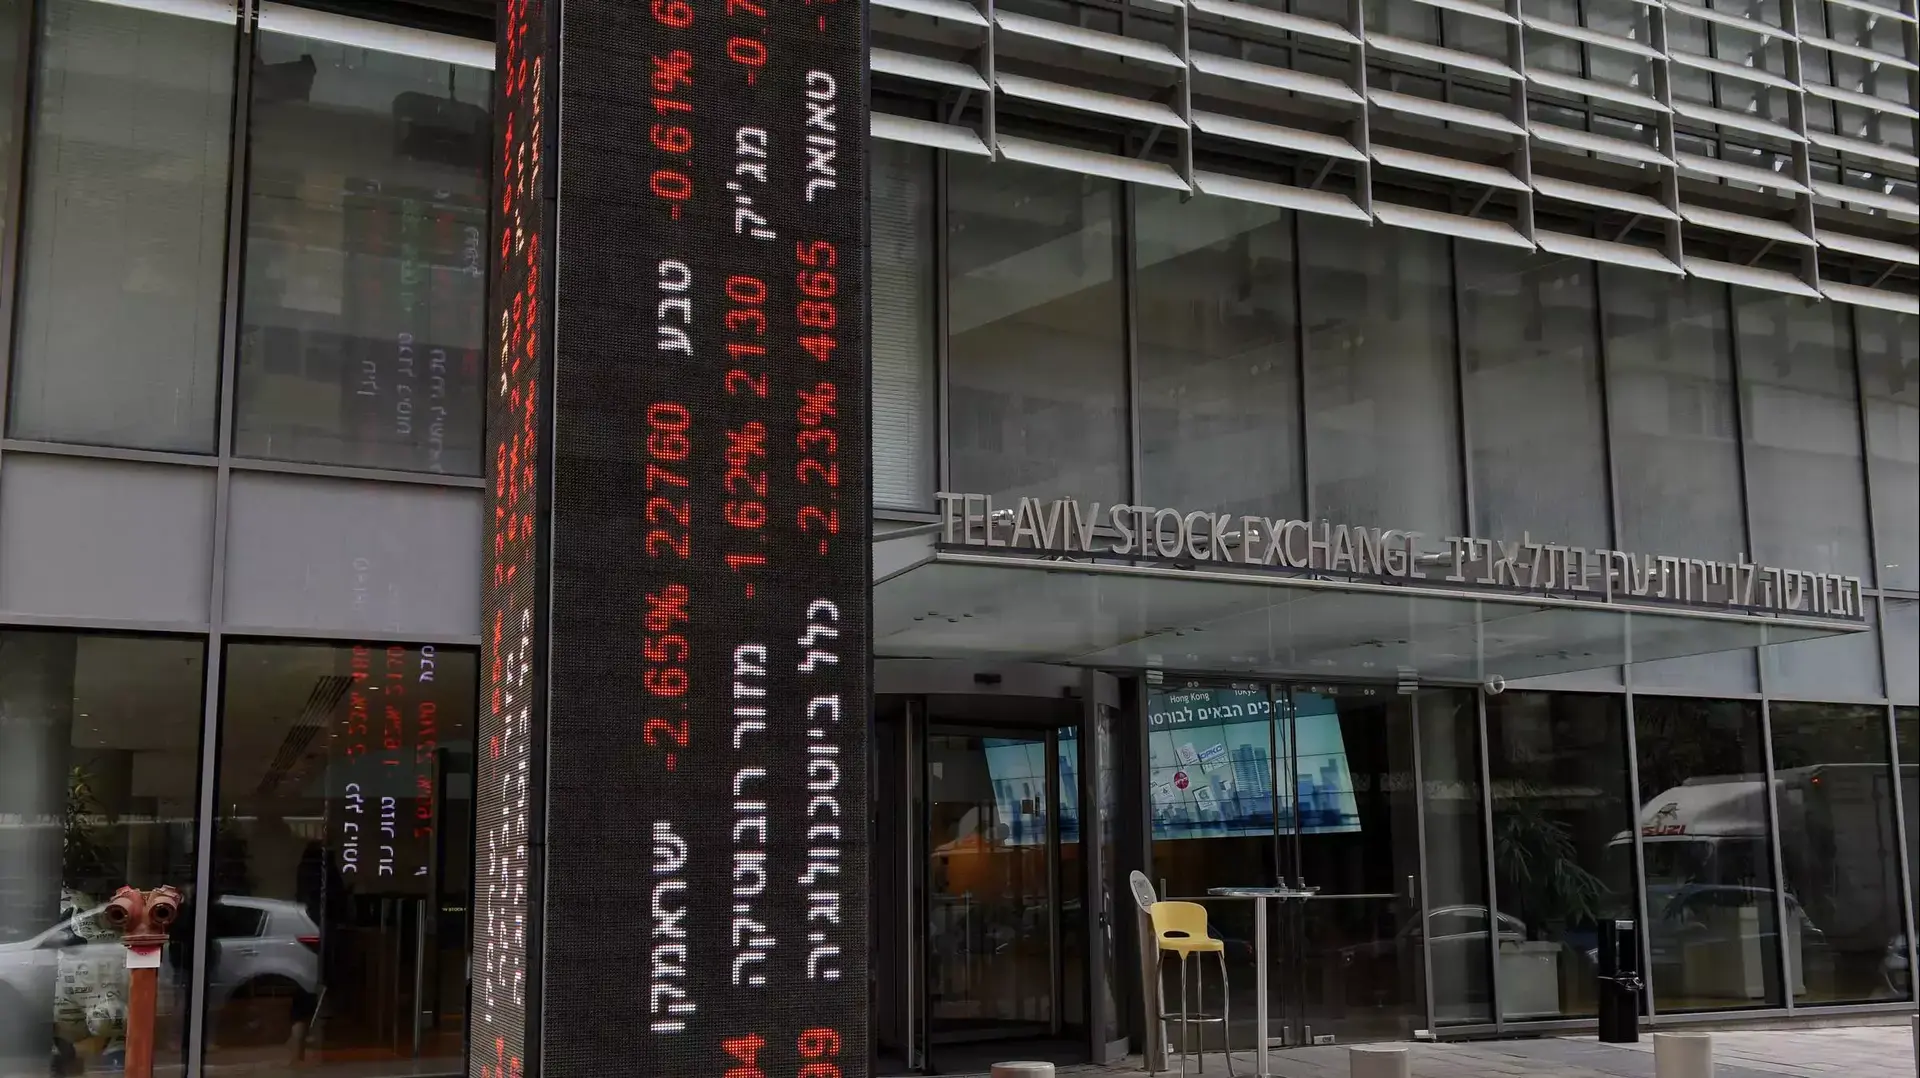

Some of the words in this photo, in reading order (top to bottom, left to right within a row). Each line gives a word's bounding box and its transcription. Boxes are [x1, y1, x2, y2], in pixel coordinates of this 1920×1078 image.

[650, 50, 691, 220] -0.61%
[727, 126, 777, 241] מג'יק
[805, 69, 836, 202] טאואר
[658, 258, 693, 356] טבע
[726, 275, 768, 398] 2130
[796, 240, 836, 362] 4865
[646, 403, 690, 559] 22760
[725, 421, 769, 599] -1.62%
[796, 382, 839, 555] -2.23%
[1109, 503, 1233, 562] STOCK
[1240, 514, 1427, 580] EXCHANGE
[1595, 549, 1650, 604] ערך
[1658, 552, 1757, 606] לניירות
[1764, 566, 1865, 617] הבורסה
[644, 584, 688, 770] -2.65%
[733, 643, 767, 749] מזור
[798, 597, 839, 674] כלל
[1170, 694, 1189, 704] Hong
[1191, 690, 1210, 702] Kong
[1197, 704, 1243, 721] הבאים
[733, 766, 777, 987] רובוטיקה
[798, 694, 842, 981] ביוטכנולוגיה
[650, 819, 697, 1034] ישראמקו
